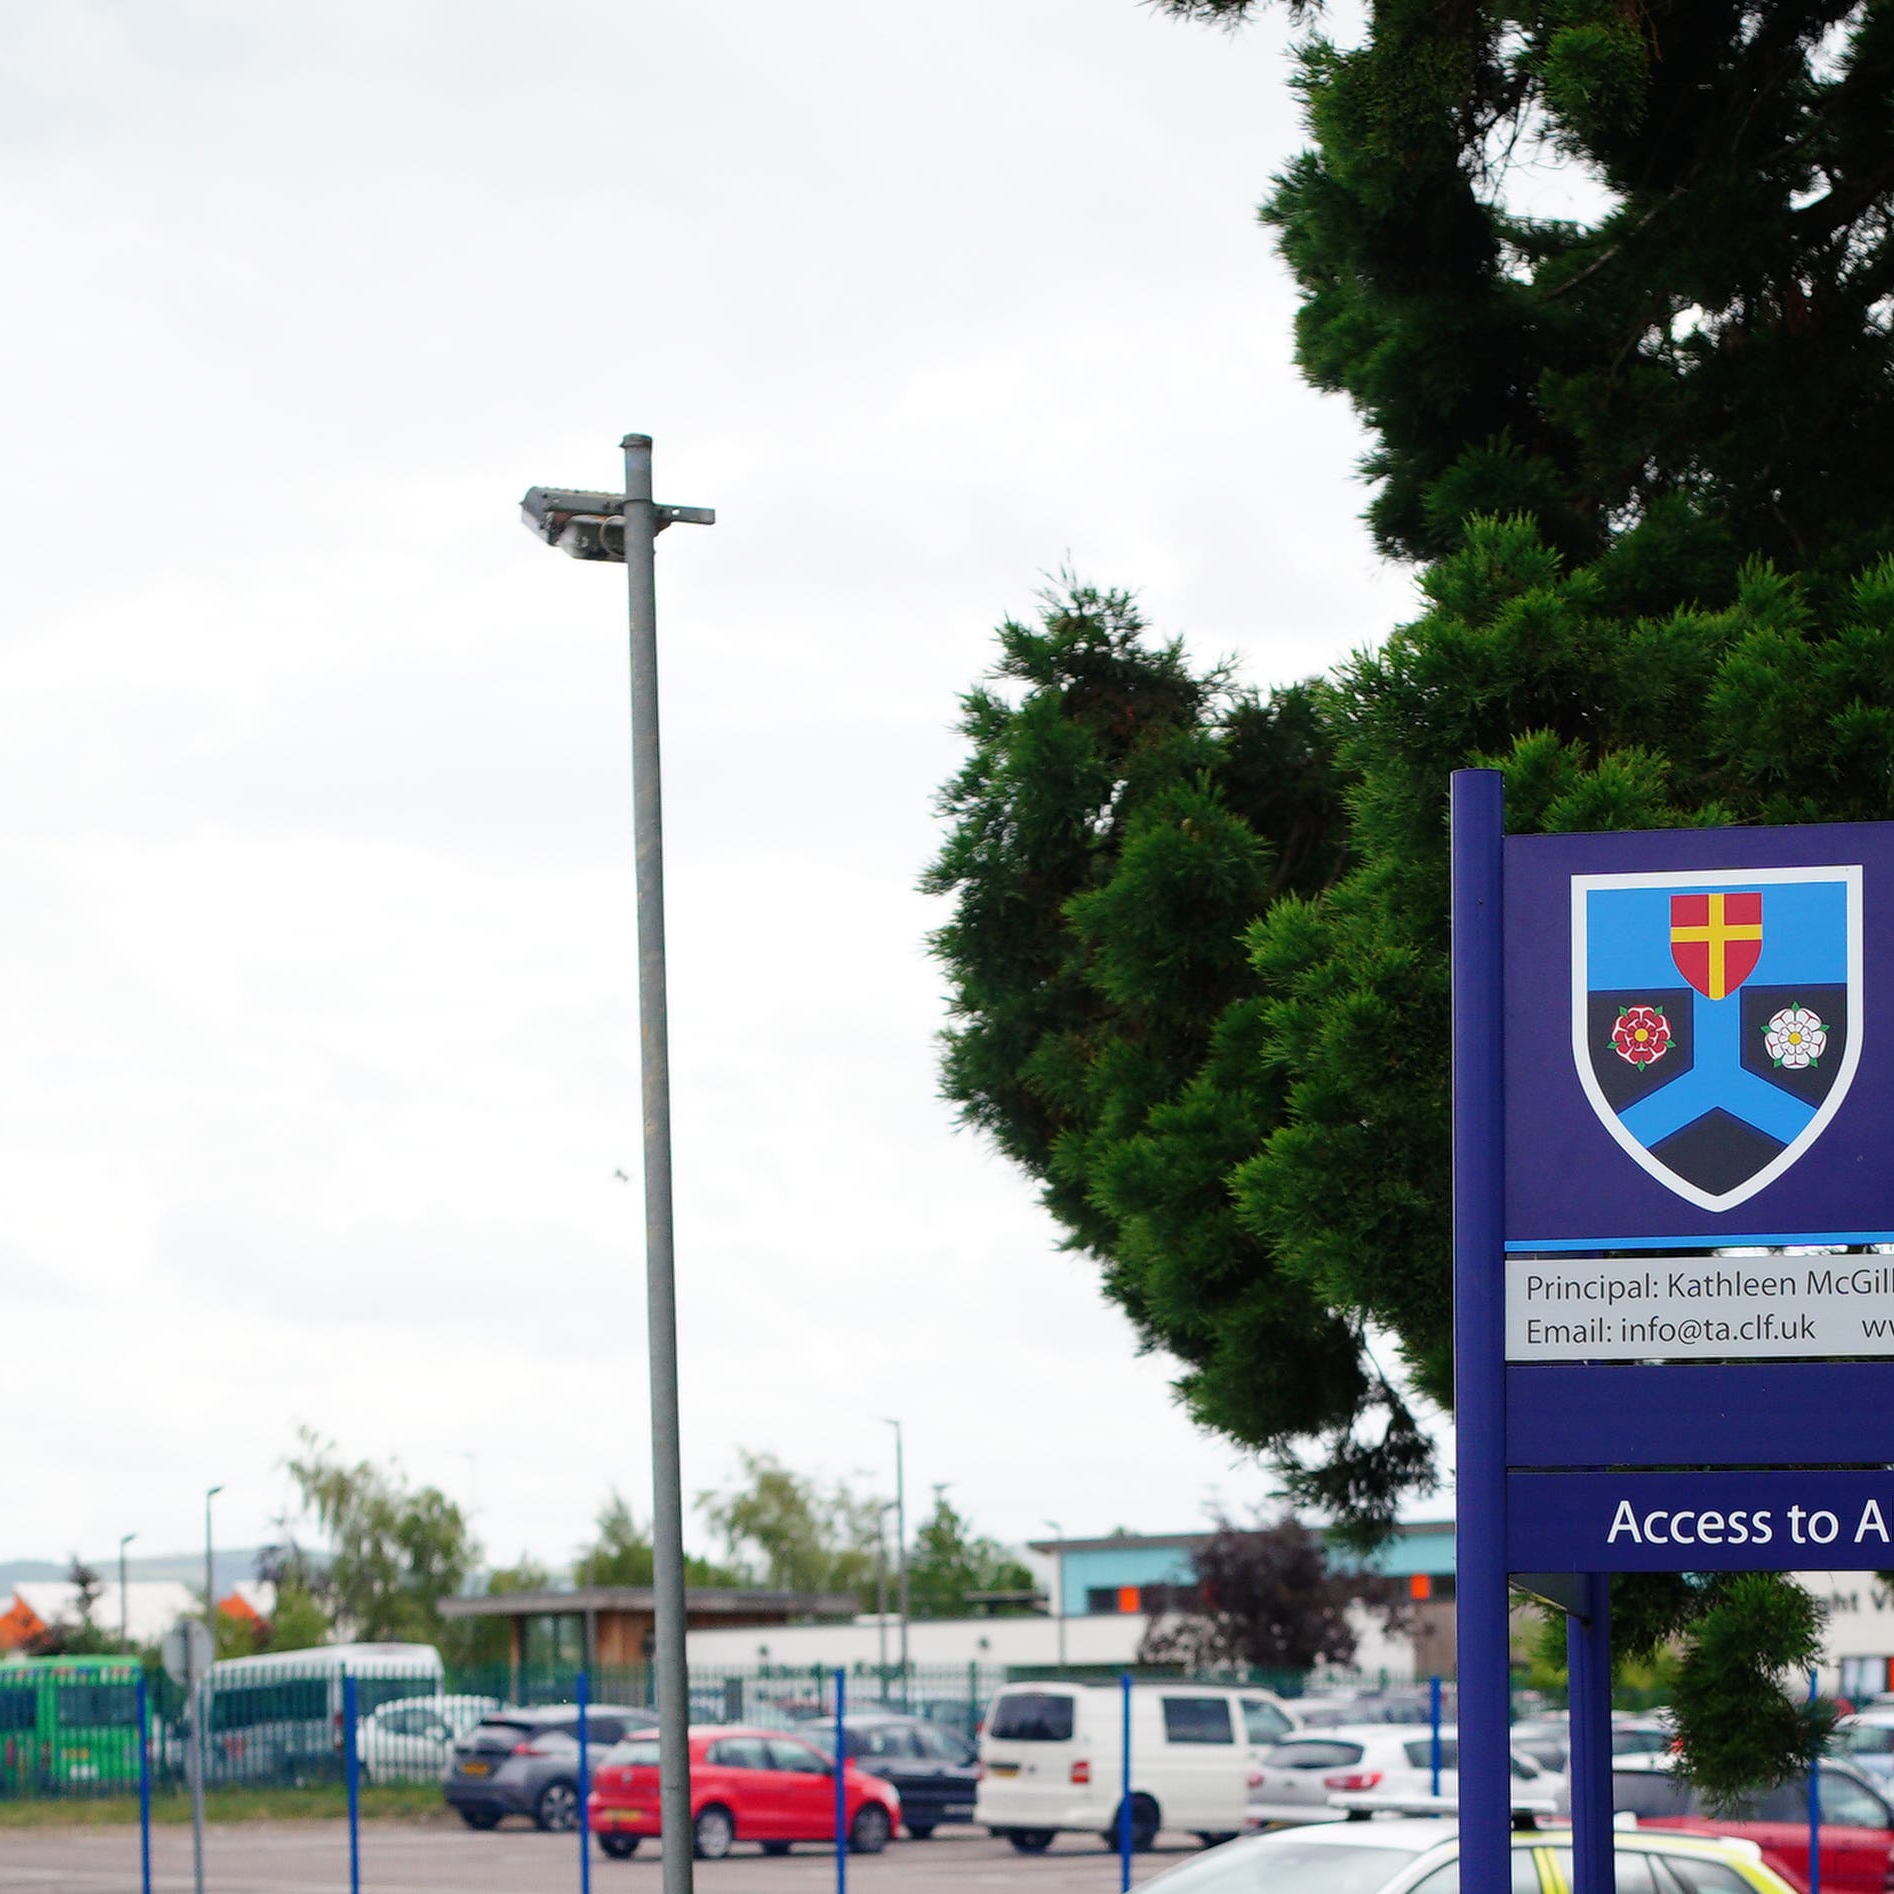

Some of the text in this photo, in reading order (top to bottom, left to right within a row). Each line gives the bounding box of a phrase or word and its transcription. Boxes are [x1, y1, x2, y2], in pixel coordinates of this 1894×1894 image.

[1528, 1273, 1658, 1305] Principal:
[1669, 1271, 1795, 1297] Kathleen
[1528, 1314, 1815, 1344] Email: info@ta.clf.uk
[1608, 1501, 1772, 1543] Access
[1787, 1505, 1838, 1543] to
